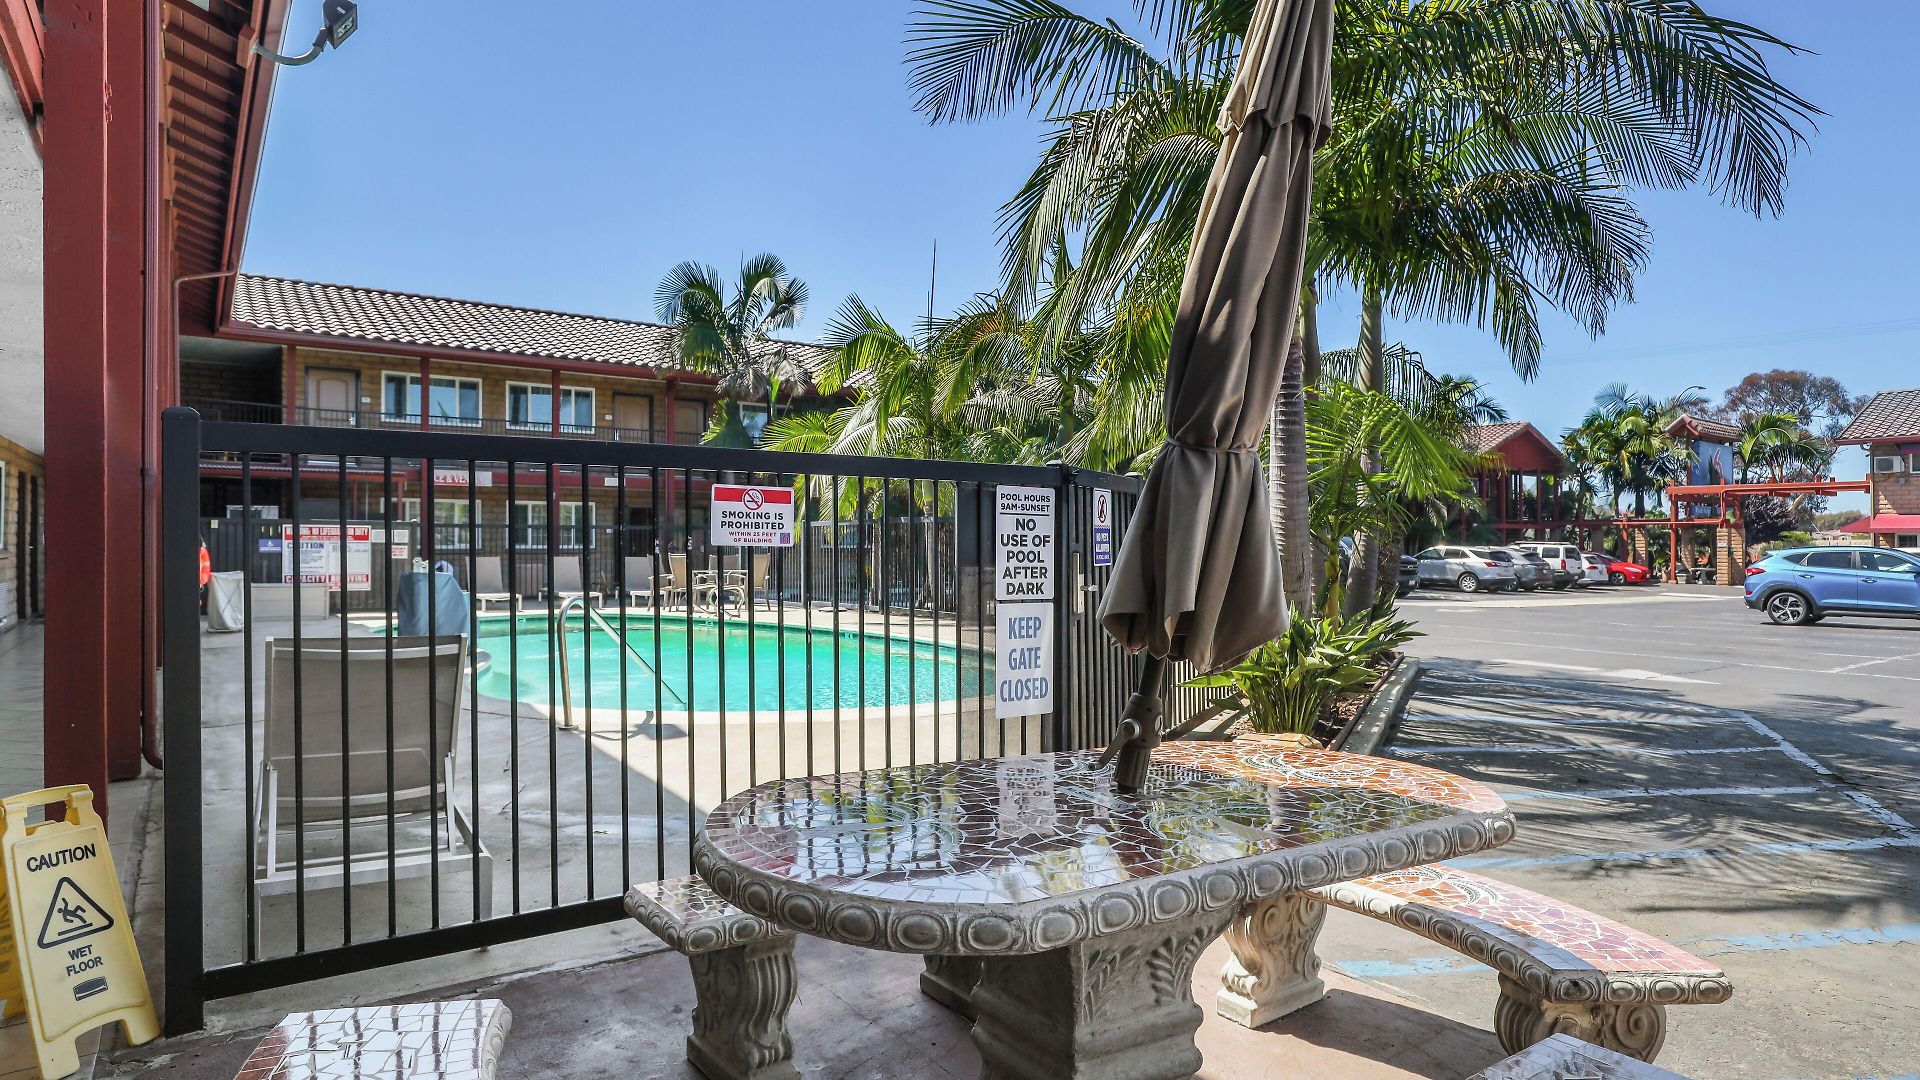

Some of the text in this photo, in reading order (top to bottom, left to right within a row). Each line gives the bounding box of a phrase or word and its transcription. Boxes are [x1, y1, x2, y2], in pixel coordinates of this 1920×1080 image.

[1000, 493, 1051, 503] POOL HOURS
[1000, 503, 1051, 512] 9AM-SUNSET
[721, 511, 784, 520] SMOKING IS
[720, 520, 785, 530] PROHIBITED
[1015, 518, 1037, 532] NO
[287, 542, 324, 550] CUTION
[1000, 534, 1051, 548] USE OF
[1006, 550, 1045, 563] POOL
[1002, 566, 1048, 580] AFTER
[1006, 582, 1045, 595] DARK
[1008, 616, 1042, 640] KEEP
[1008, 646, 1041, 671] GATE
[1000, 677, 1049, 703] CLOSED
[26, 843, 97, 873] CAUTION
[68, 944, 93, 961] WET
[65, 956, 104, 976] FLOOR
